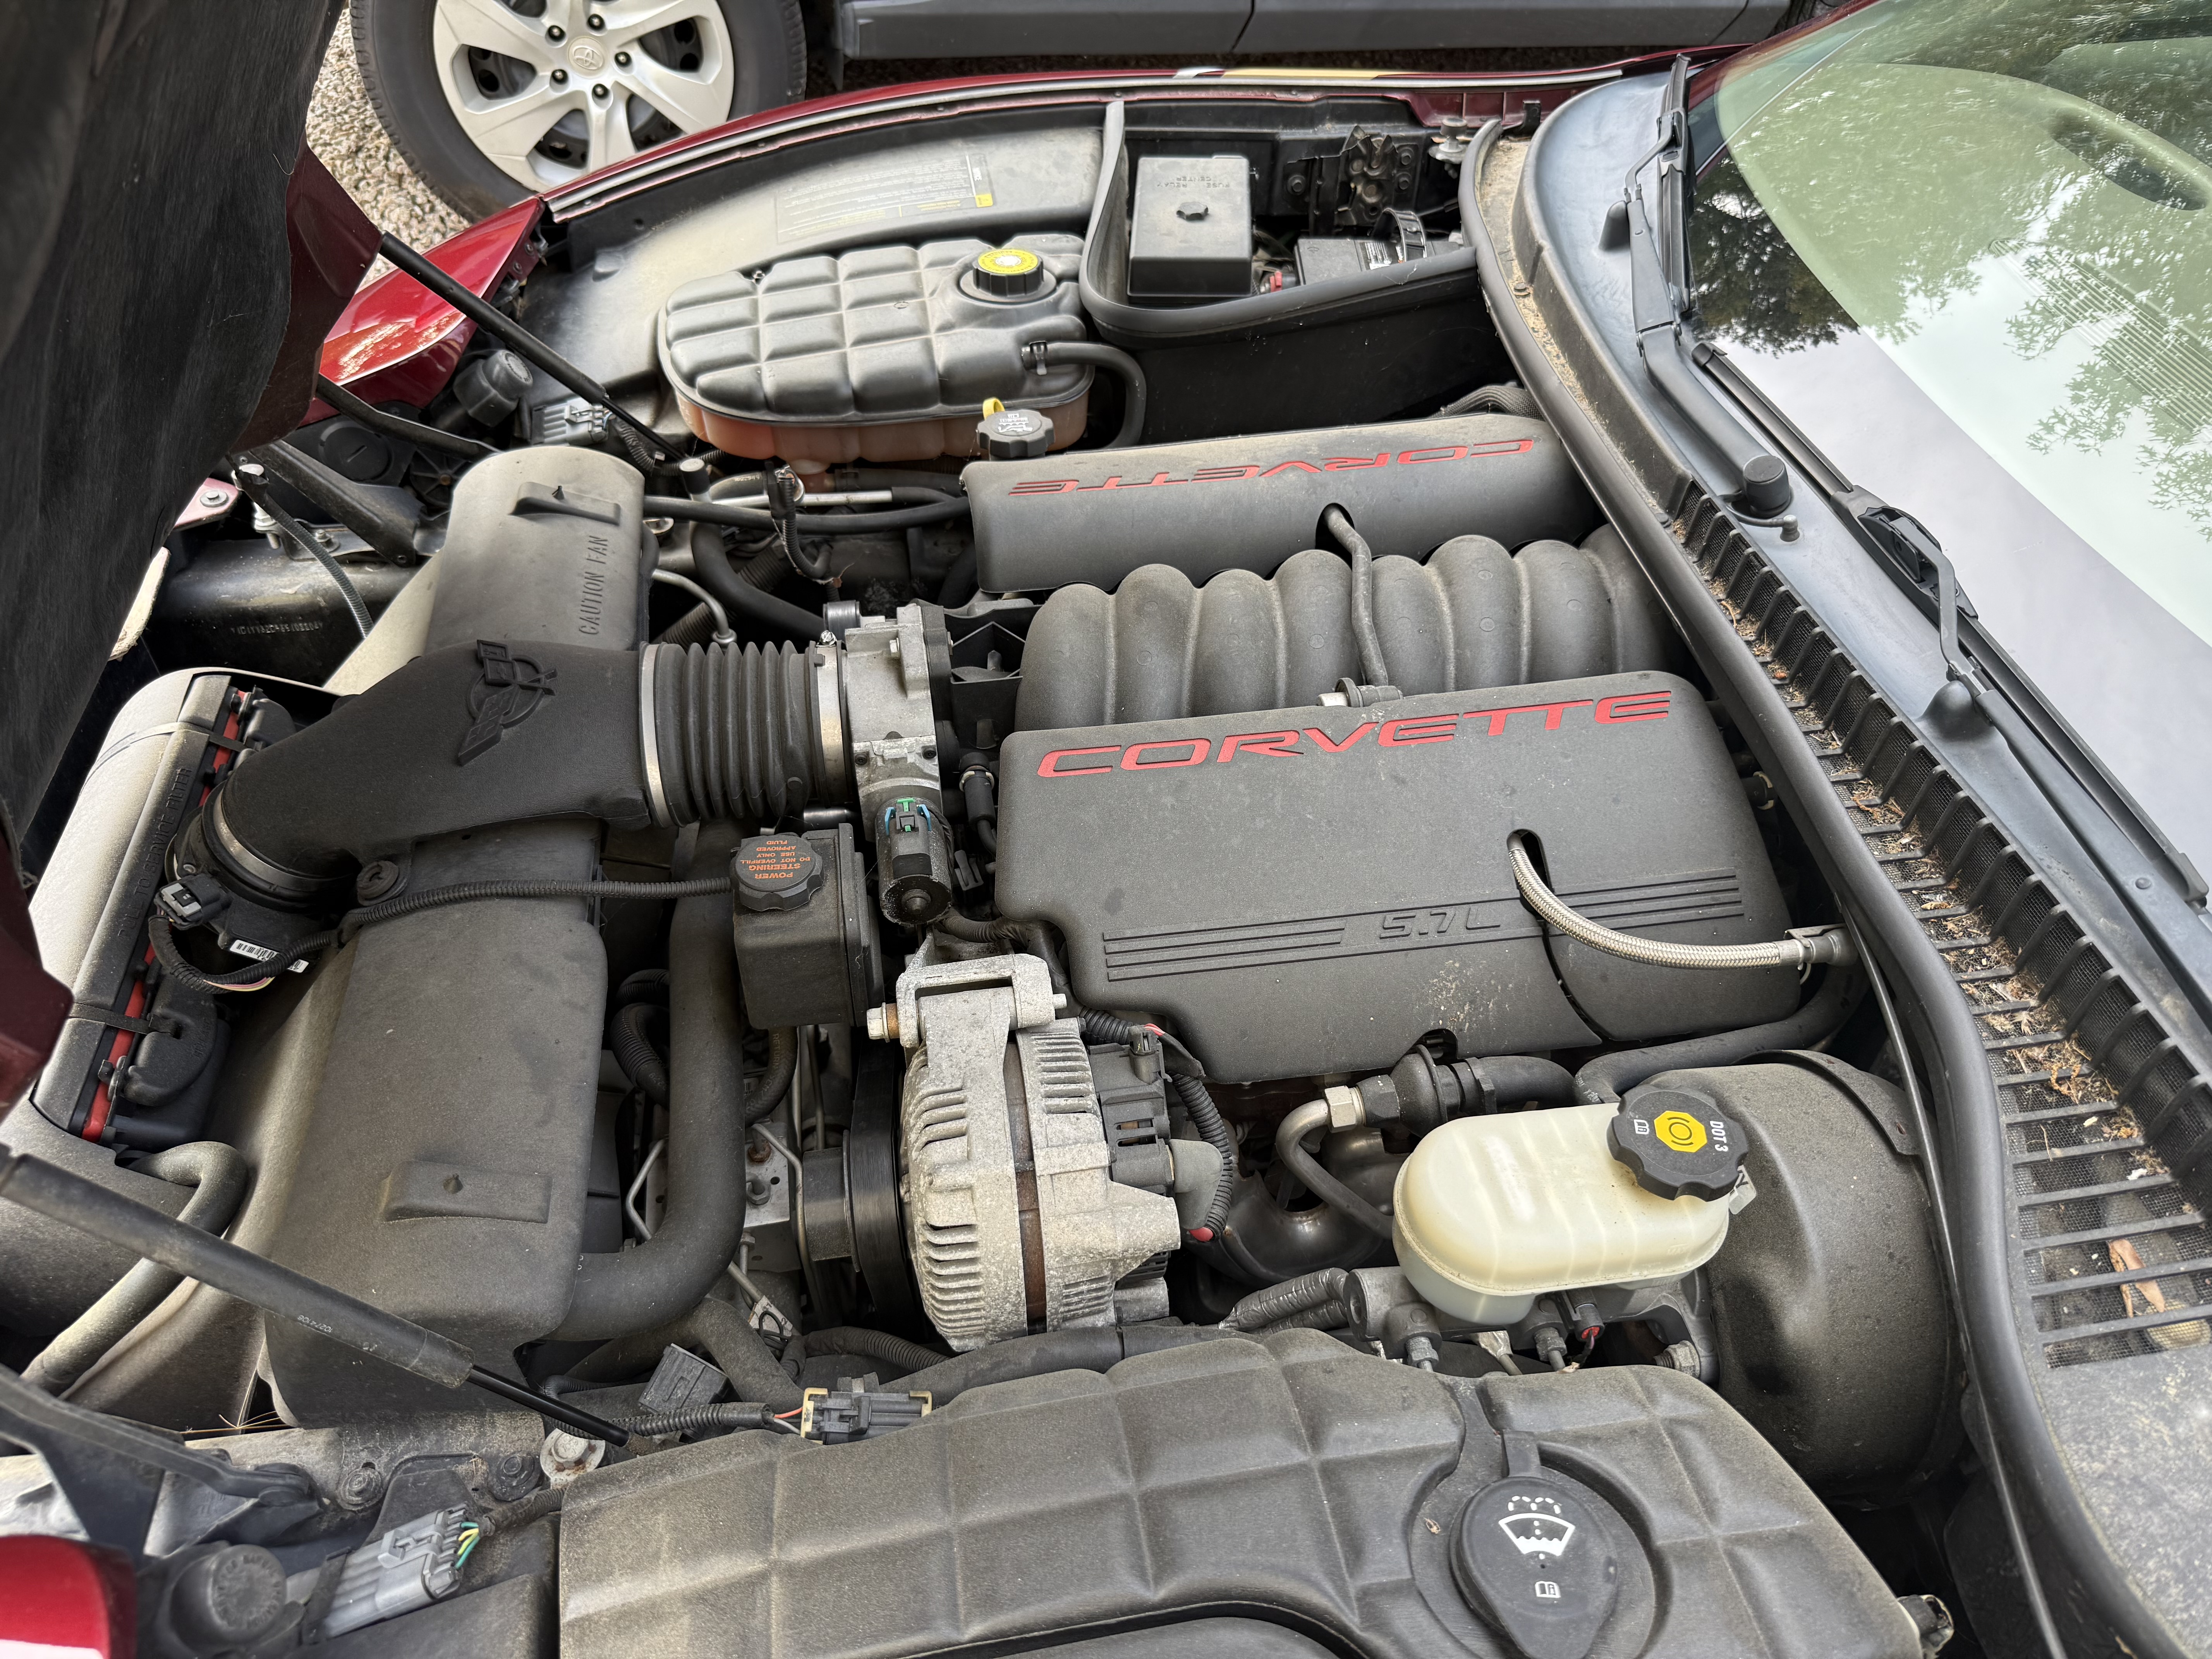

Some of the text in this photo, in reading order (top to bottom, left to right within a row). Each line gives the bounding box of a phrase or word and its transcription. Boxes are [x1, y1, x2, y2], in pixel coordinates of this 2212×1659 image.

[1009, 439, 1534, 495] CORVETTE
[578, 535, 608, 635] CAUTION FAN
[1037, 692, 1672, 778] CORVETTE
[117, 765, 193, 941] PULL TO SERVICE FILTER
[1378, 907, 1502, 940] 5.7L
[1709, 1120, 1729, 1152] DOT 3
